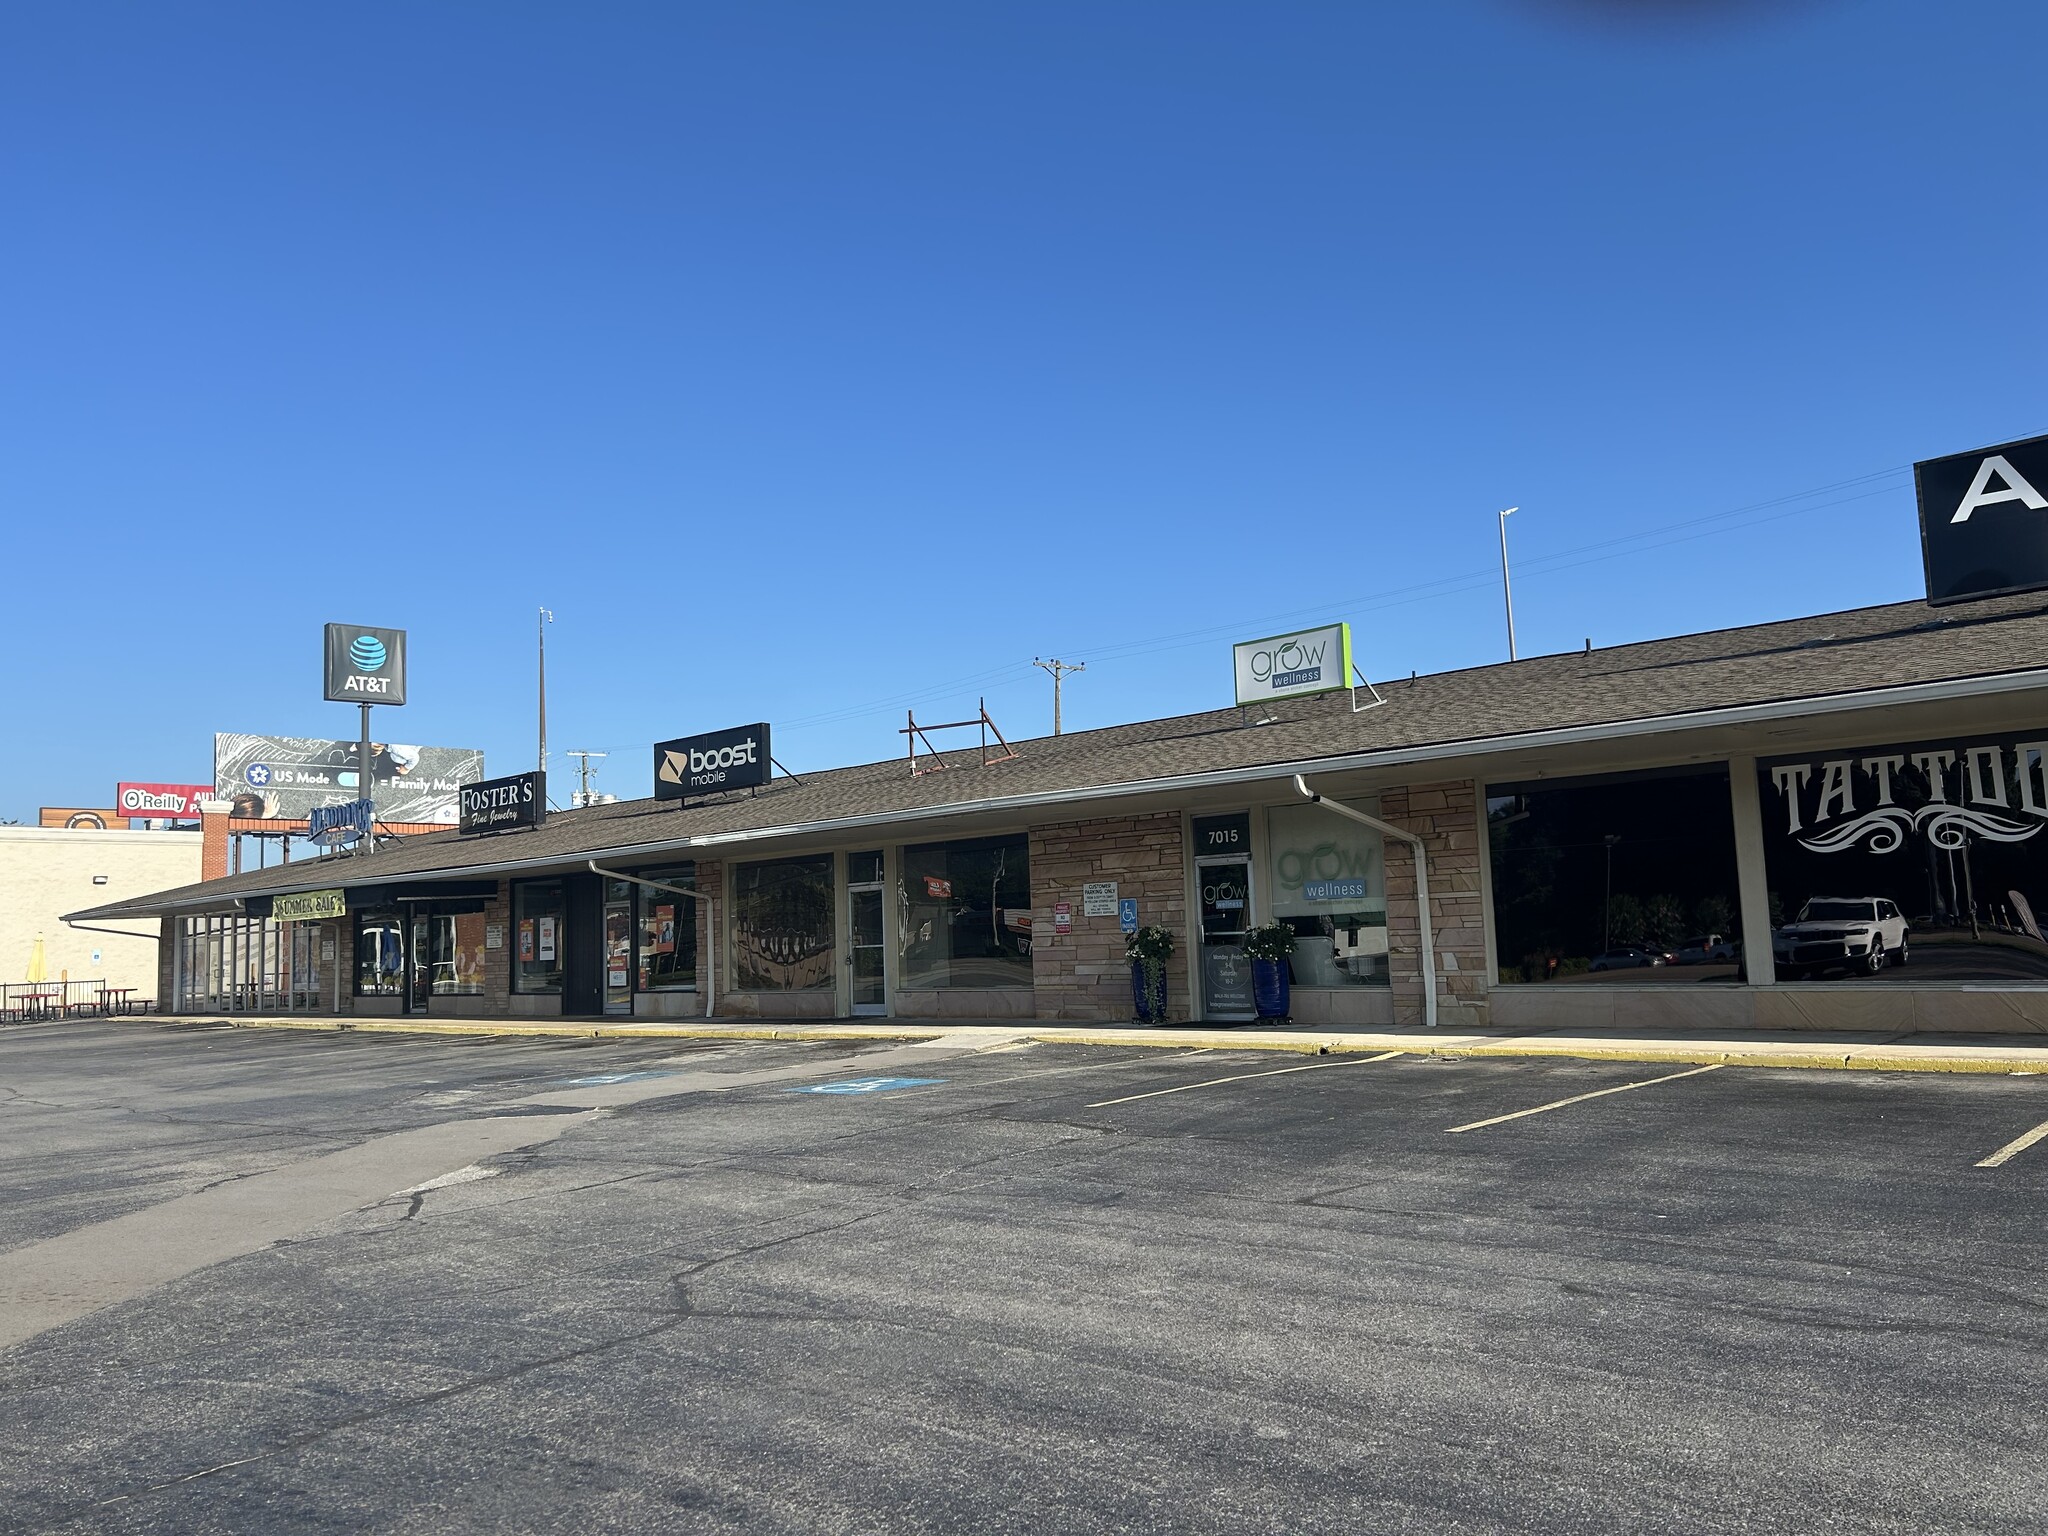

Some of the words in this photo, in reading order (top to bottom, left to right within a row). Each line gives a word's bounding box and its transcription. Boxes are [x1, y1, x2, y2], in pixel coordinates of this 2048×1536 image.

[1251, 640, 1327, 683] grow
[344, 675, 391, 693] AT&T
[1274, 670, 1319, 686] wellness
[690, 737, 757, 773] boost
[274, 771, 294, 783] US
[297, 772, 330, 785] Mode
[392, 777, 431, 793] Family
[691, 771, 727, 787] mobile
[124, 790, 186, 811] O'Reilly
[460, 778, 533, 818] FOSTER'S
[308, 799, 374, 842] ALADDIN'S
[471, 812, 487, 826] Fine
[490, 808, 518, 825] Jewelry
[325, 831, 347, 845] CAFE
[1208, 829, 1239, 844] 7015
[1278, 843, 1372, 891] grow
[1203, 882, 1247, 905] grow
[1306, 883, 1363, 897] wellness
[279, 898, 313, 915] SUMMER
[316, 896, 337, 911] SALE
[1216, 900, 1243, 909] wellness
